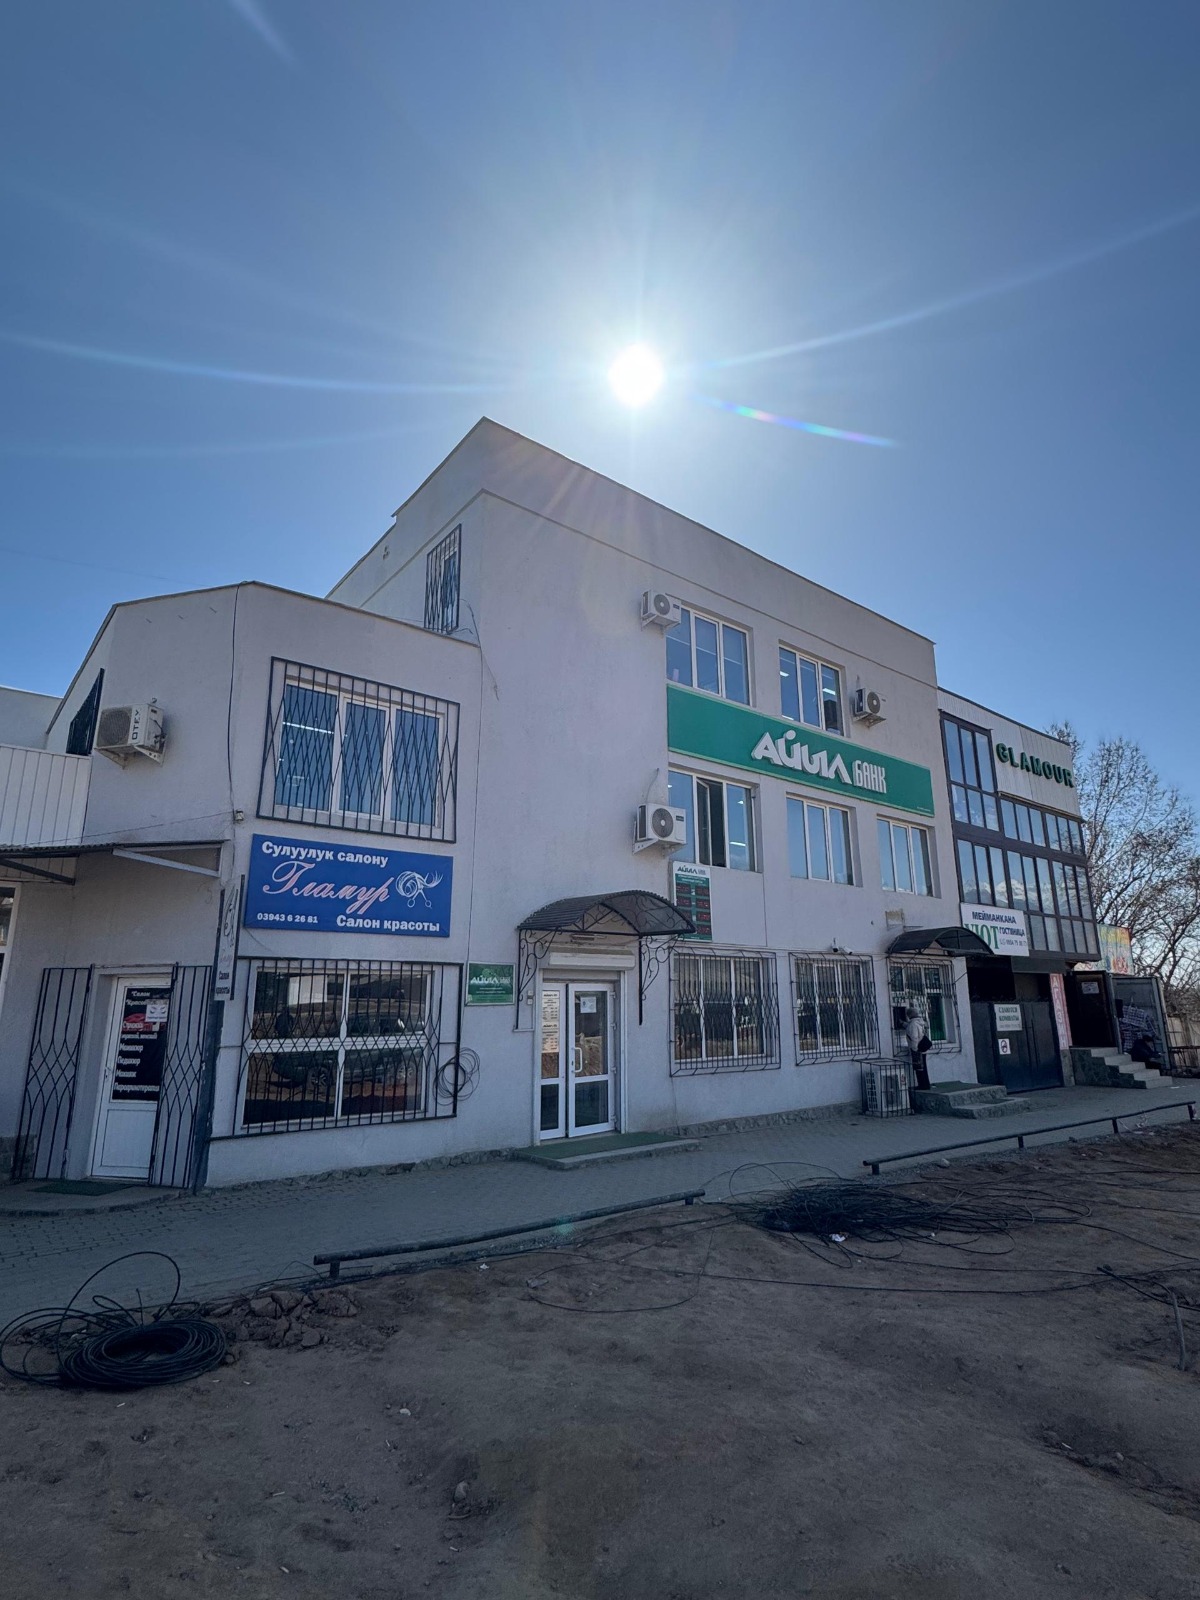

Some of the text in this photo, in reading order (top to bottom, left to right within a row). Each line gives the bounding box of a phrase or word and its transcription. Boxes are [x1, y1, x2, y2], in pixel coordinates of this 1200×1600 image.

[852, 759, 887, 794] БАНК
[995, 742, 1074, 788] GLAMOUR
[261, 841, 389, 868] Сулуулук салону
[262, 860, 394, 915] Гламур
[256, 912, 319, 924] 03943 6 26 81
[336, 914, 440, 932] Салон красоты
[971, 910, 1017, 924] МЕЙМАНКАНА
